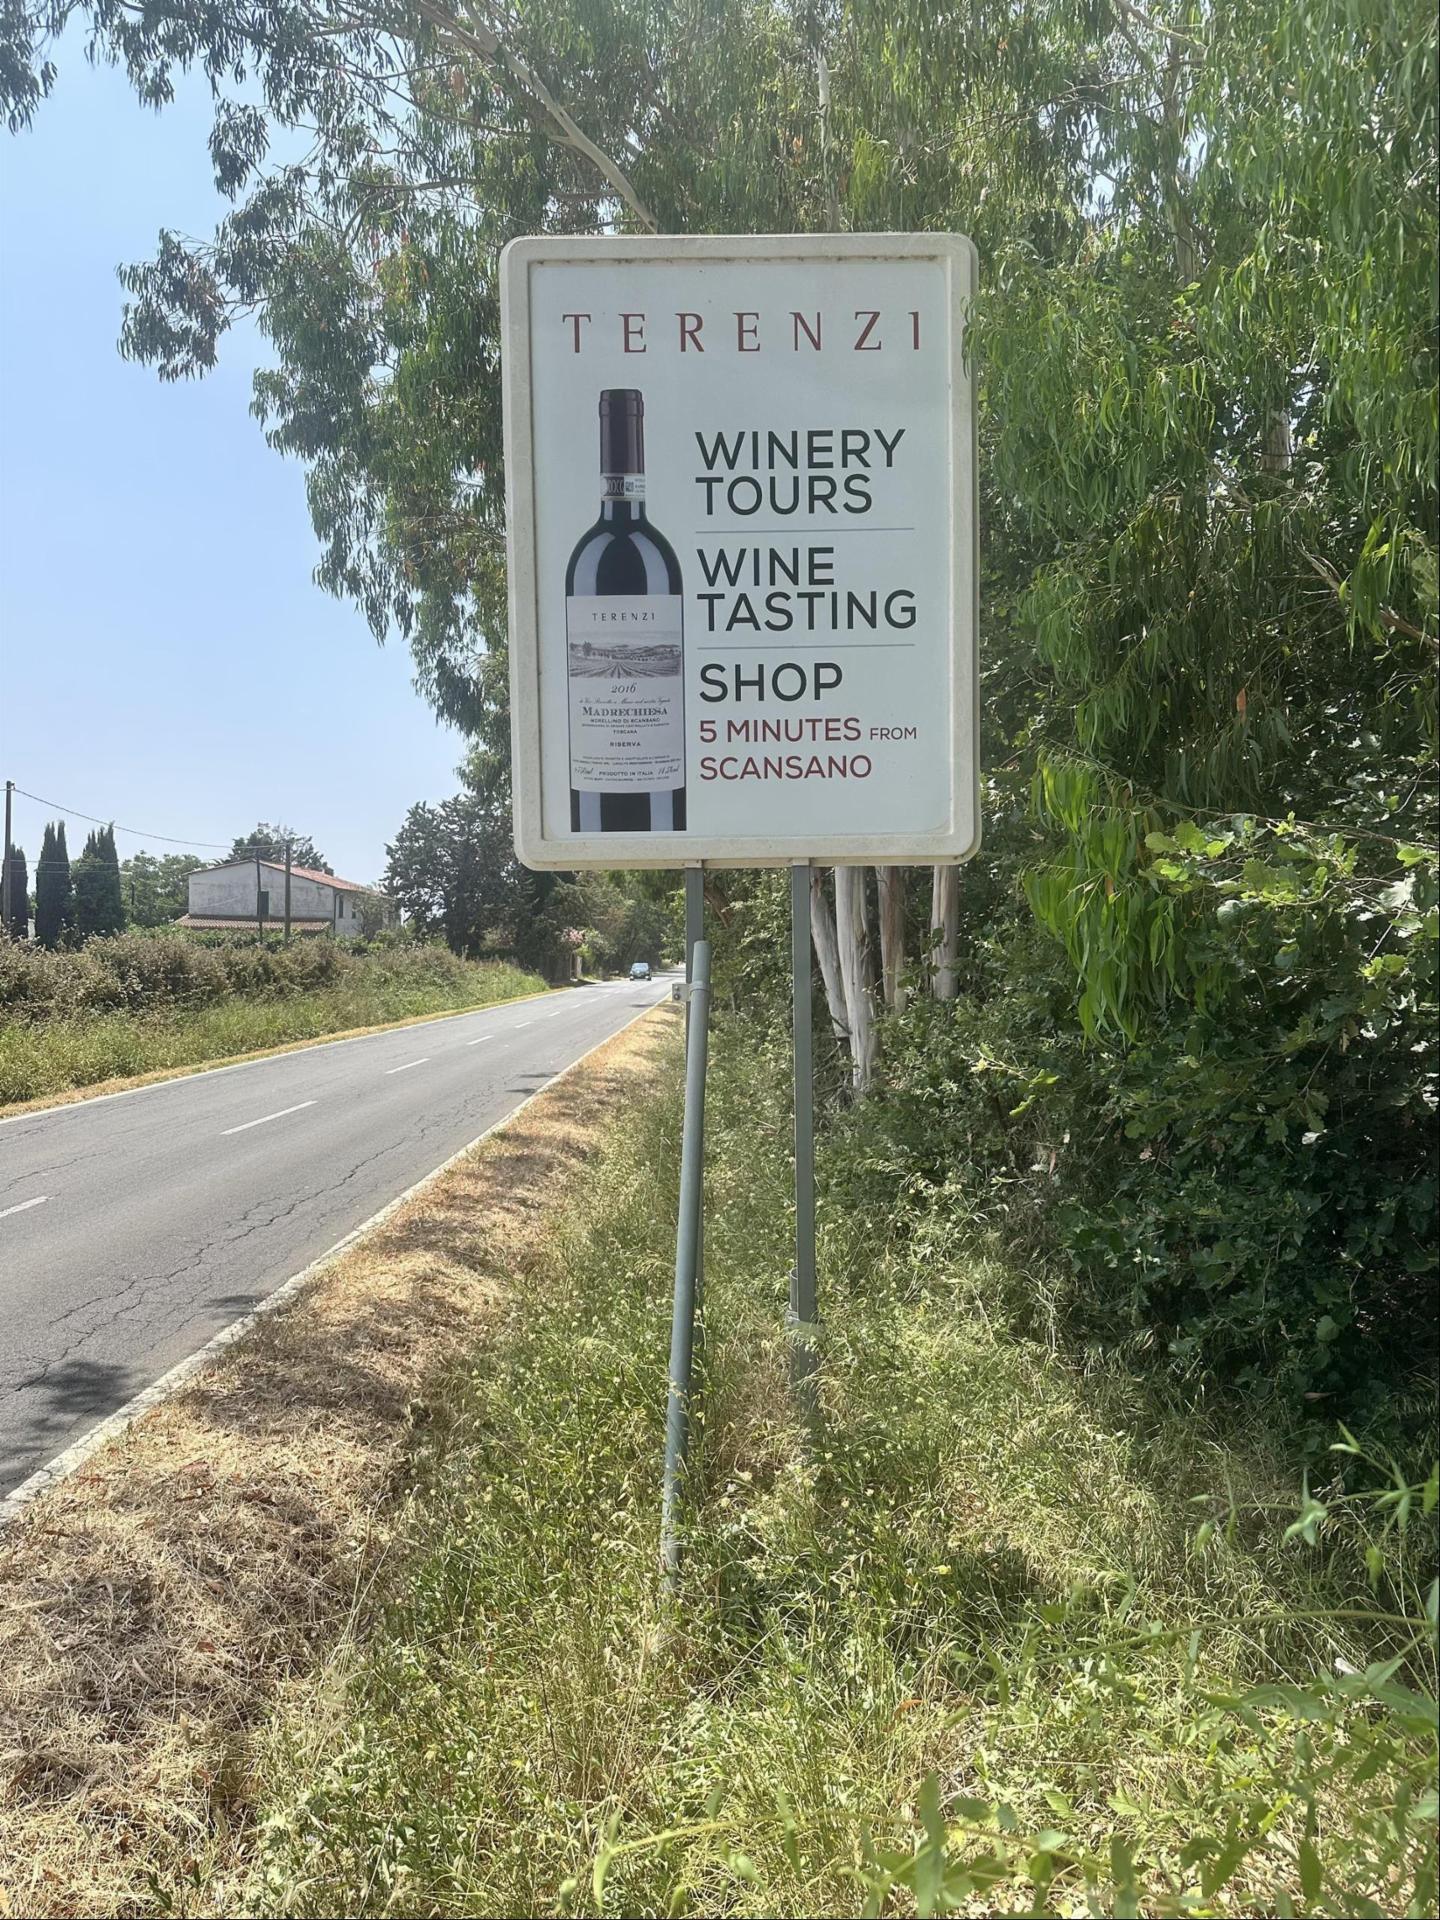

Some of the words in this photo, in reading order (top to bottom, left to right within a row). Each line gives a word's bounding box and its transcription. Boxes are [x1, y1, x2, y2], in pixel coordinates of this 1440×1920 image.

[563, 311, 920, 353] TERENZI
[695, 429, 905, 470] WINERY
[695, 474, 872, 515] TOURS
[696, 547, 834, 587] WINE
[592, 612, 655, 621] TERENZI
[697, 590, 916, 632] TASTING
[611, 682, 637, 693] 2016
[699, 663, 842, 702] SHOP
[699, 719, 717, 743] 5
[727, 718, 861, 742] MINUTES
[870, 726, 917, 740] FROM
[700, 755, 872, 780] SCANSANO
